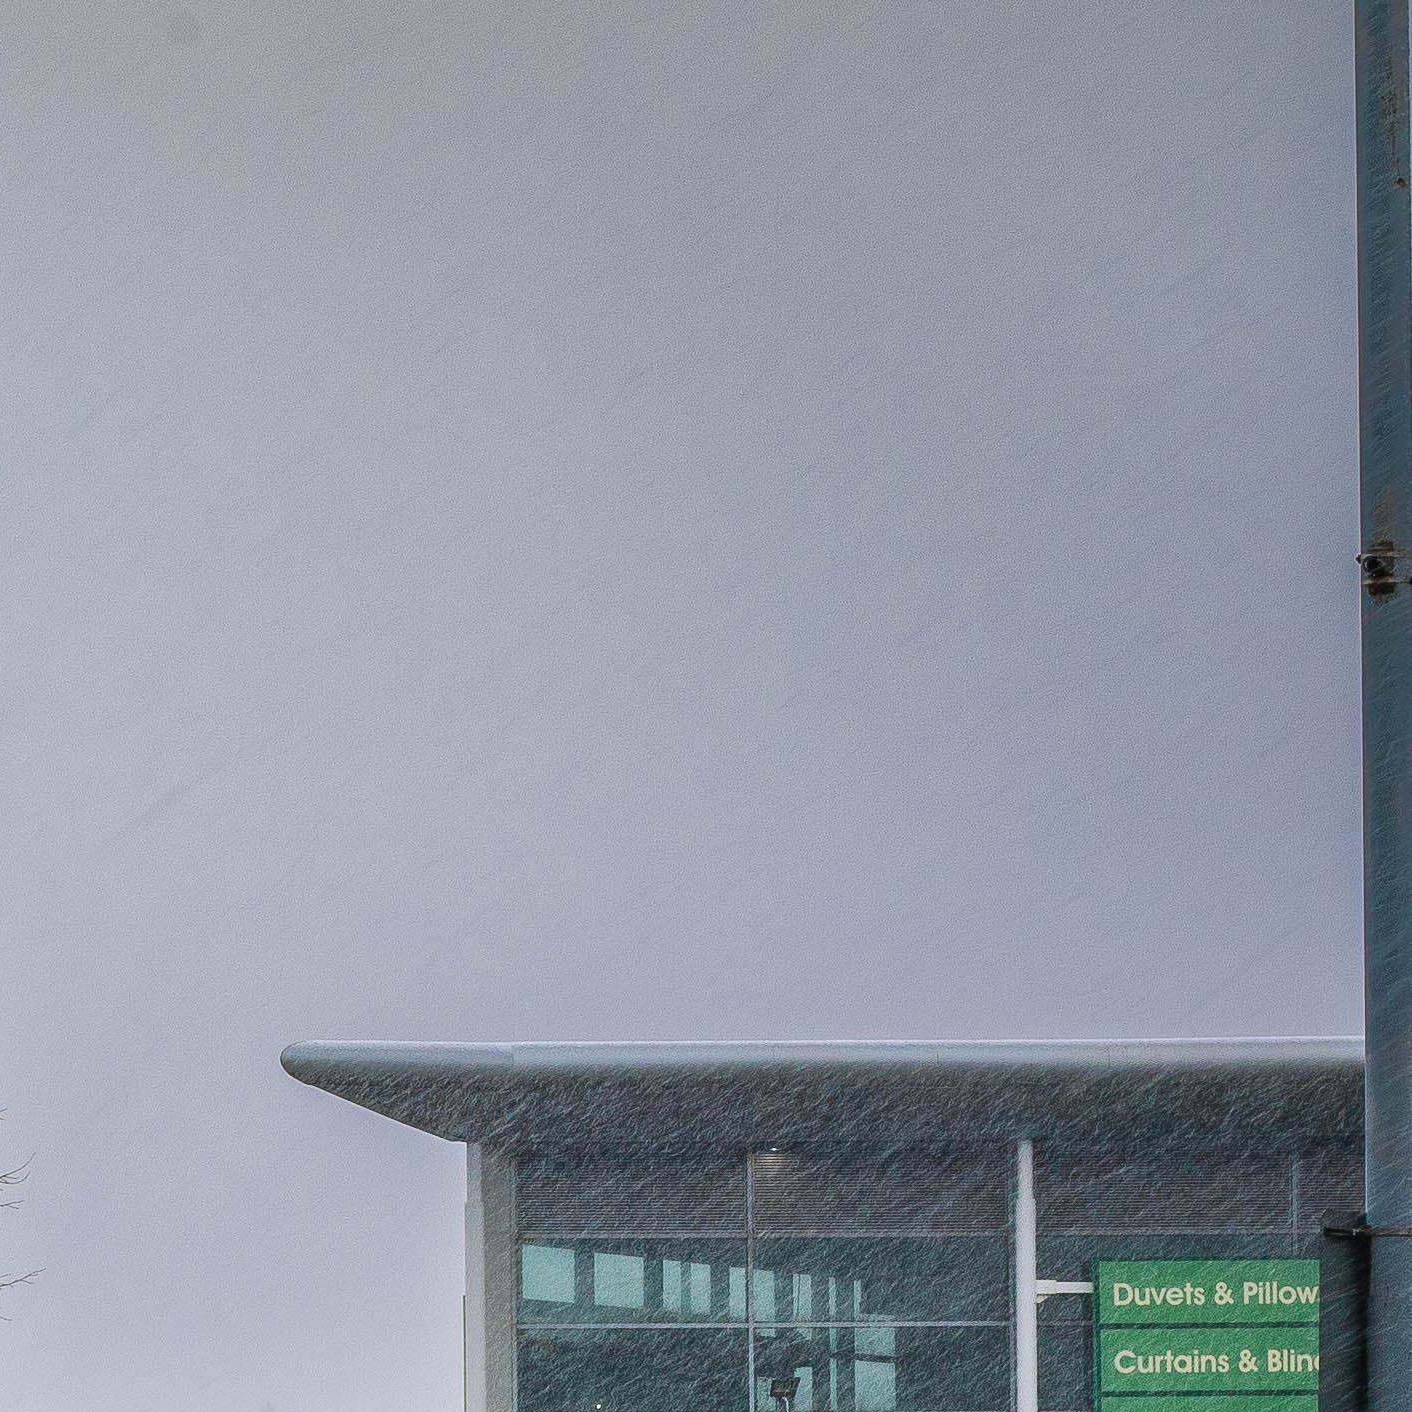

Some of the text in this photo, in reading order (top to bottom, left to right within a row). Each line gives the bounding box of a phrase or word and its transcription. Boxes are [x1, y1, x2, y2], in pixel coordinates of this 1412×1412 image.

[1113, 1282, 1206, 1306] Duvets
[1214, 1281, 1235, 1306] &
[1114, 1349, 1230, 1374] Curtains
[1238, 1349, 1259, 1373] &
